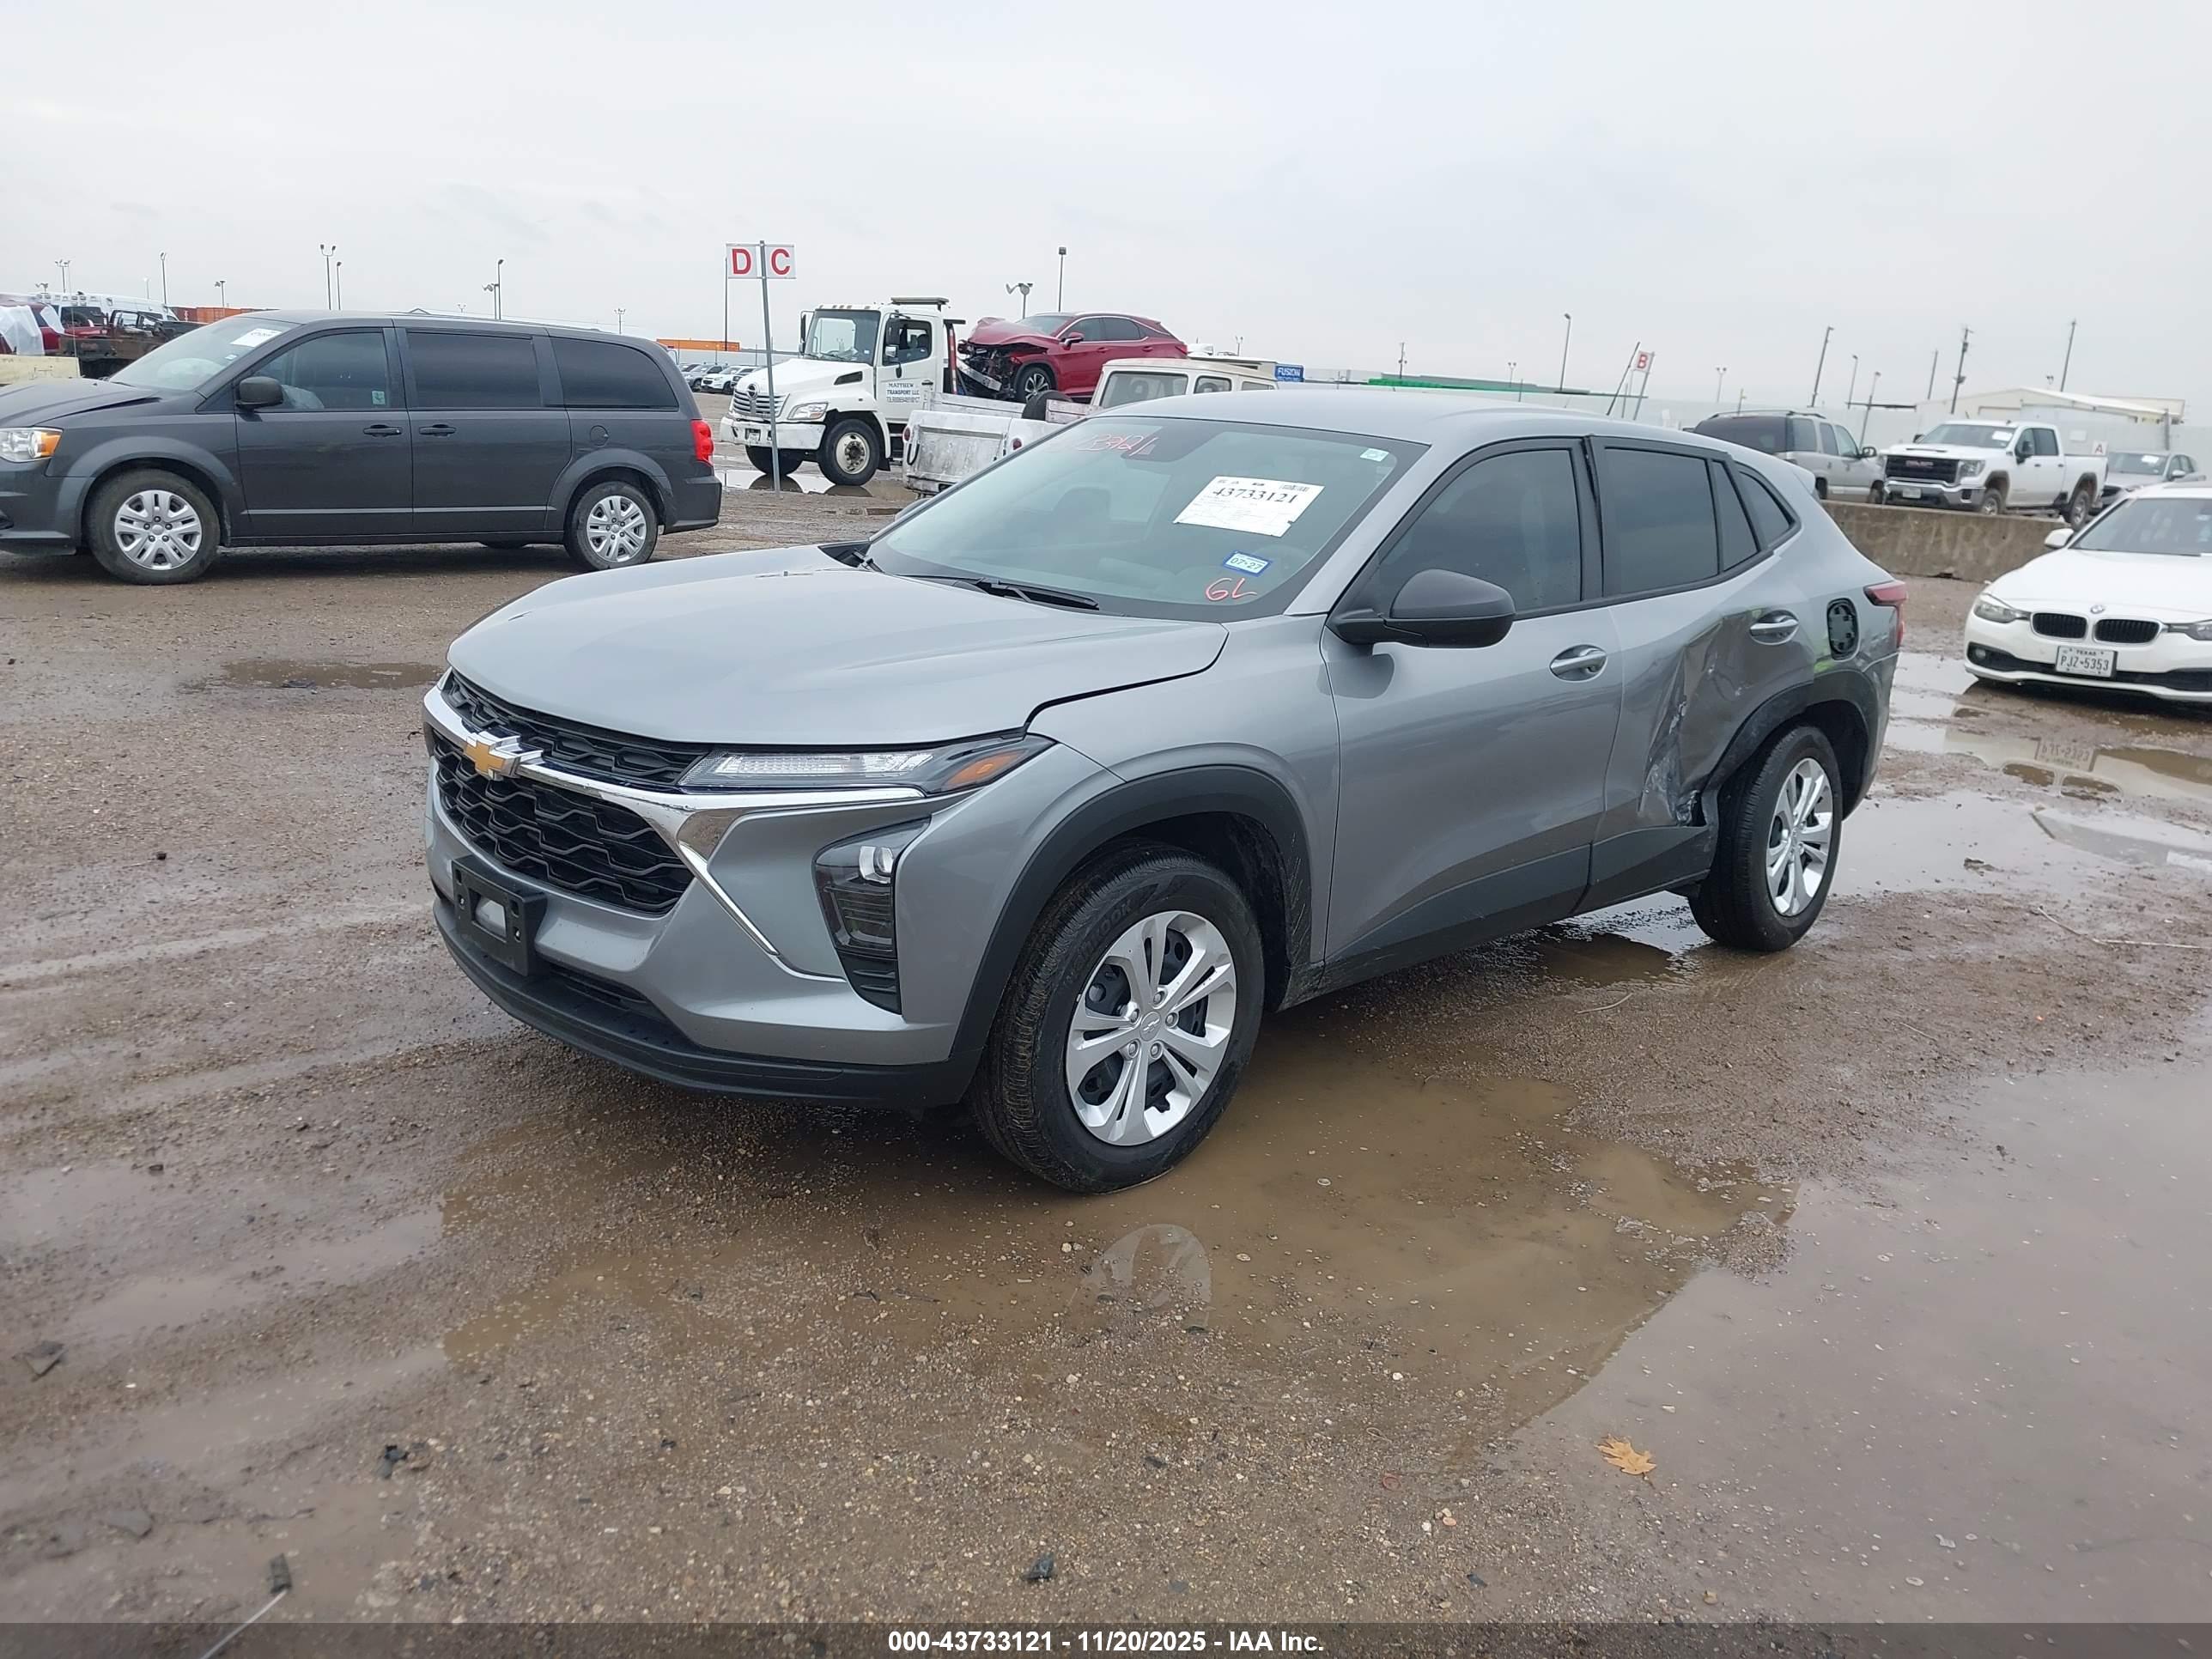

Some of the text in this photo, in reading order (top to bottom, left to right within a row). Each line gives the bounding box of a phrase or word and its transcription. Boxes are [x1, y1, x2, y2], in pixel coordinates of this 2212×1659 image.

[732, 248, 752, 275] D
[771, 248, 791, 275] C
[1637, 354, 1649, 369] B
[2094, 443, 2103, 454] A
[1212, 487, 1298, 504] 43733121
